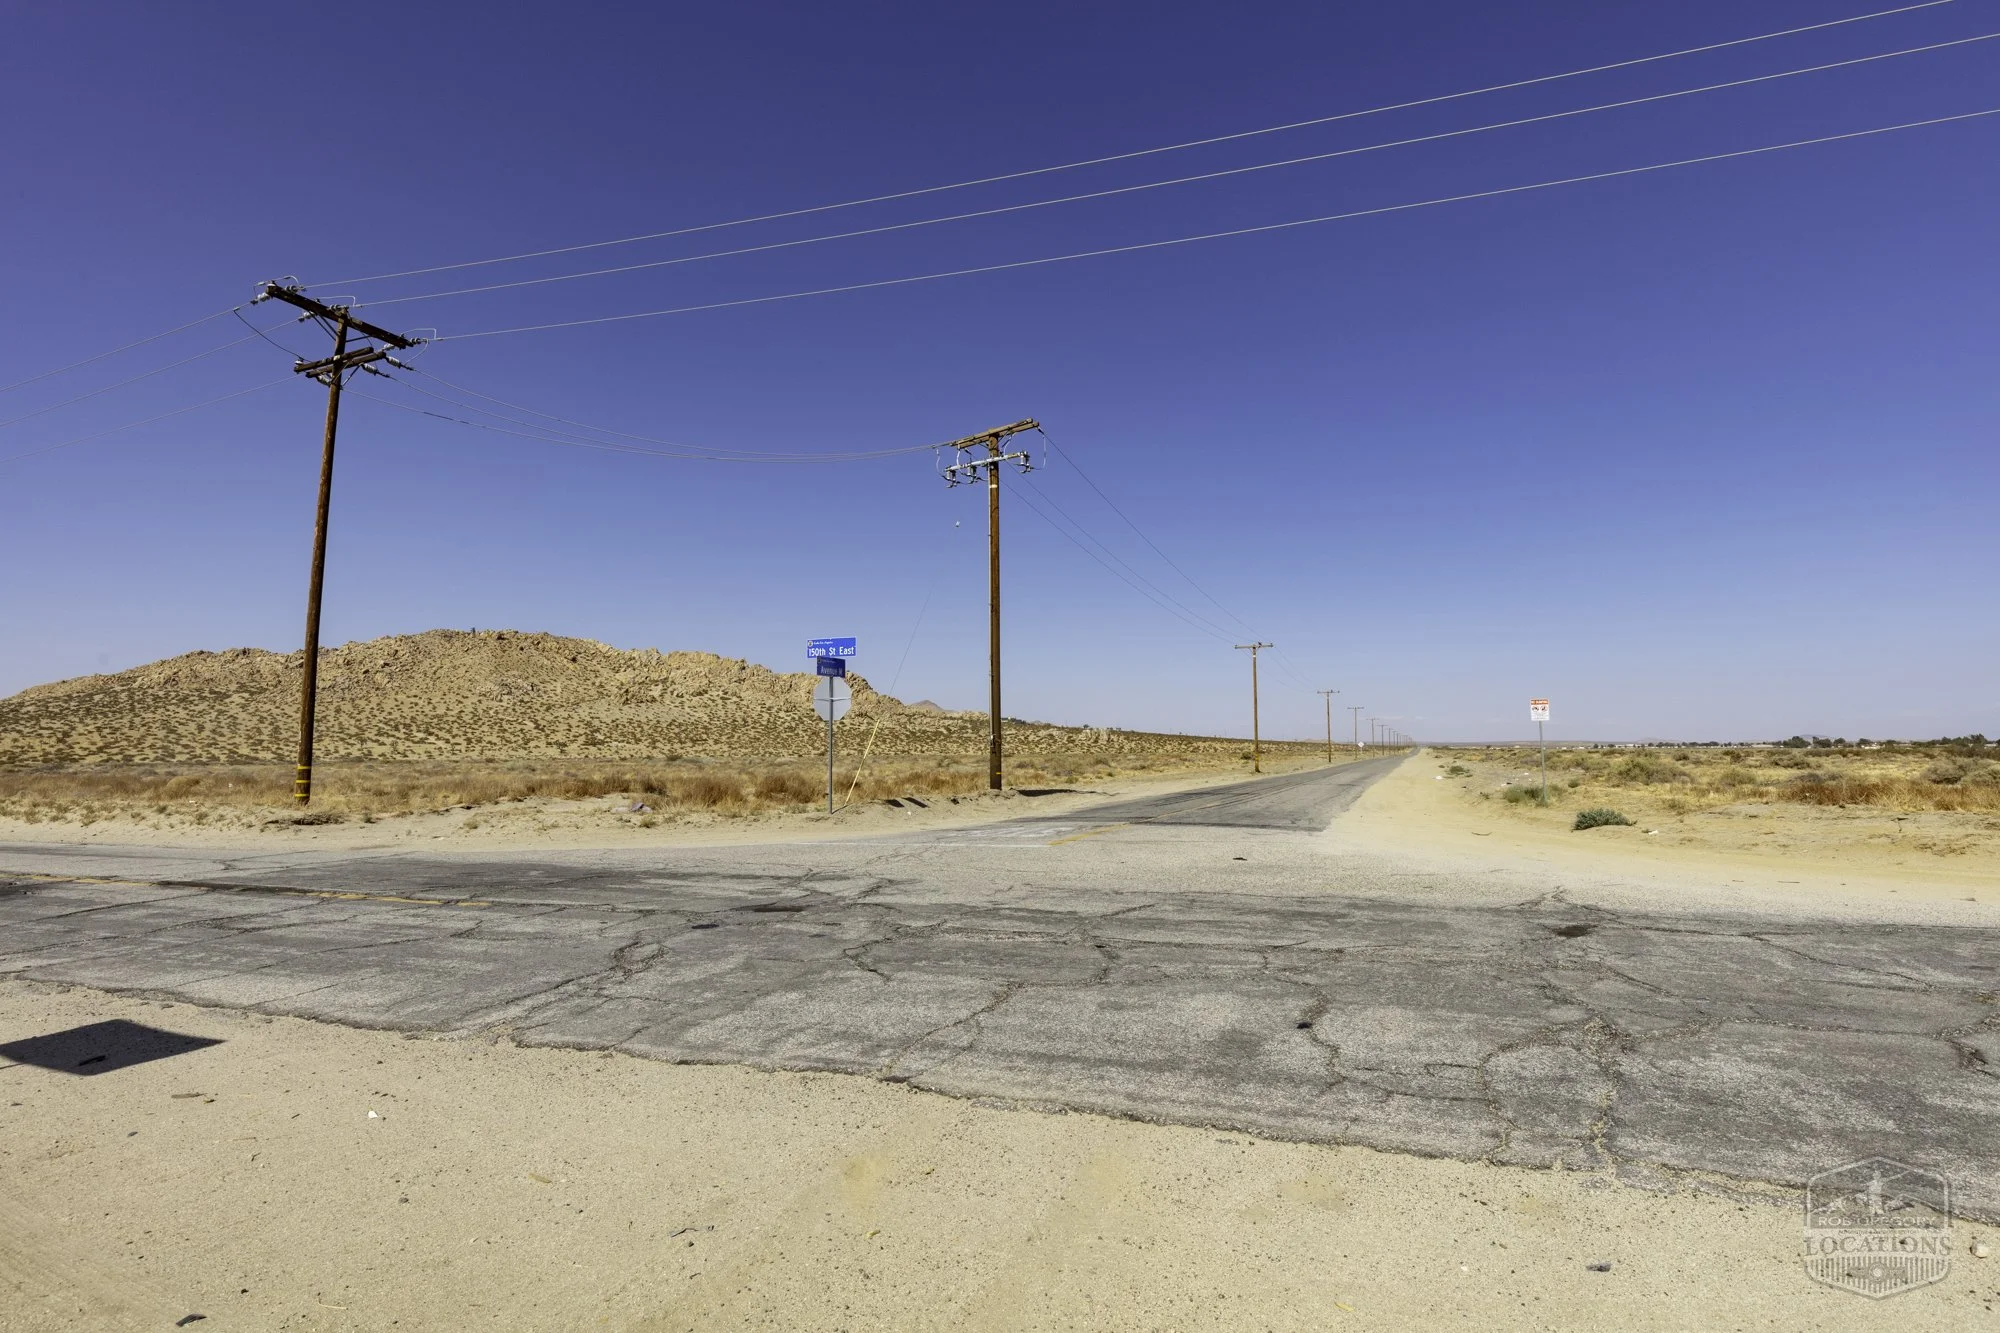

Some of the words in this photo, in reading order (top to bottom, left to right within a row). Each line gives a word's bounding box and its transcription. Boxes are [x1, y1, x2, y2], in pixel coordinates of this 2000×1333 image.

[808, 647, 826, 657] 150th
[829, 646, 836, 656] St
[840, 646, 854, 655] East
[820, 665, 838, 675] Avenue
